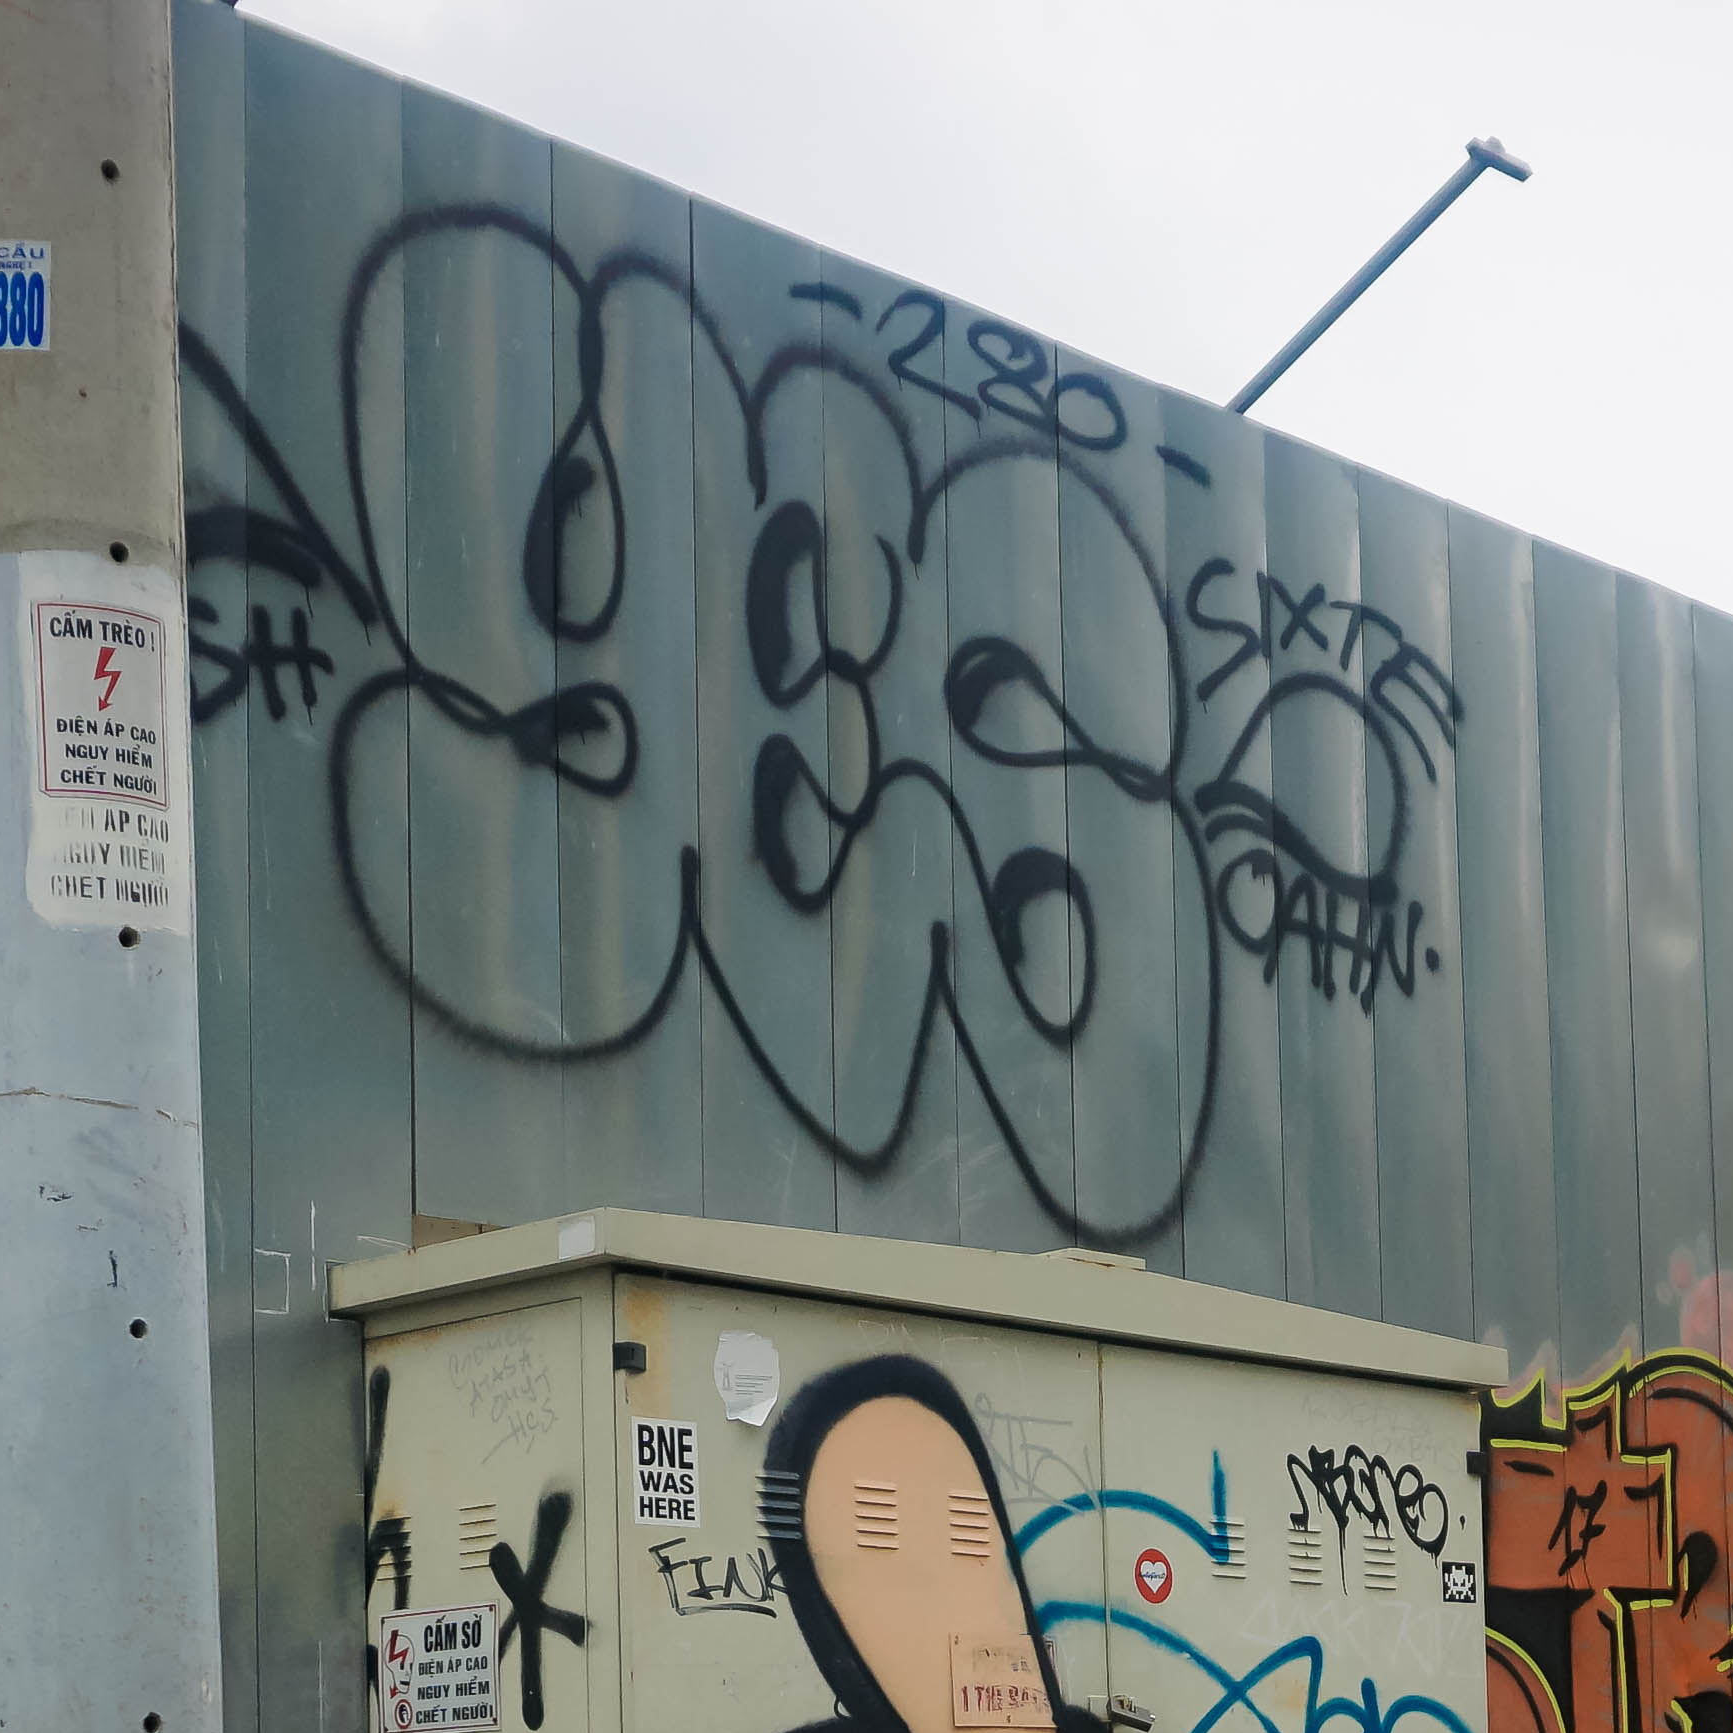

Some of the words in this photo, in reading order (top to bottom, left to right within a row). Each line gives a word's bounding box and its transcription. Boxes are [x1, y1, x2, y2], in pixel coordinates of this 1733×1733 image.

[50, 610, 93, 640] CẤM
[99, 620, 146, 649] TRÈO
[56, 715, 98, 736] ĐIỆN
[104, 718, 126, 737] ÁP
[130, 727, 157, 745] CAO
[65, 744, 109, 760] NGUY
[116, 744, 153, 769] HIỂM
[60, 765, 107, 786] CHẾT
[113, 773, 157, 796] NGƯỜI
[637, 1424, 694, 1470] BNE
[639, 1470, 694, 1494] WAS
[640, 1496, 696, 1521] HERE
[423, 1615, 457, 1653] CẤM
[461, 1613, 482, 1649] SỜ
[418, 1659, 444, 1678] ĐIỆN
[447, 1656, 462, 1672] ÁP
[466, 1656, 488, 1671] CAO
[417, 1684, 450, 1700] NGUY
[456, 1676, 490, 1697] HIỂM
[415, 1705, 447, 1724] CHẾT
[452, 1702, 493, 1721] NGƯỜI
